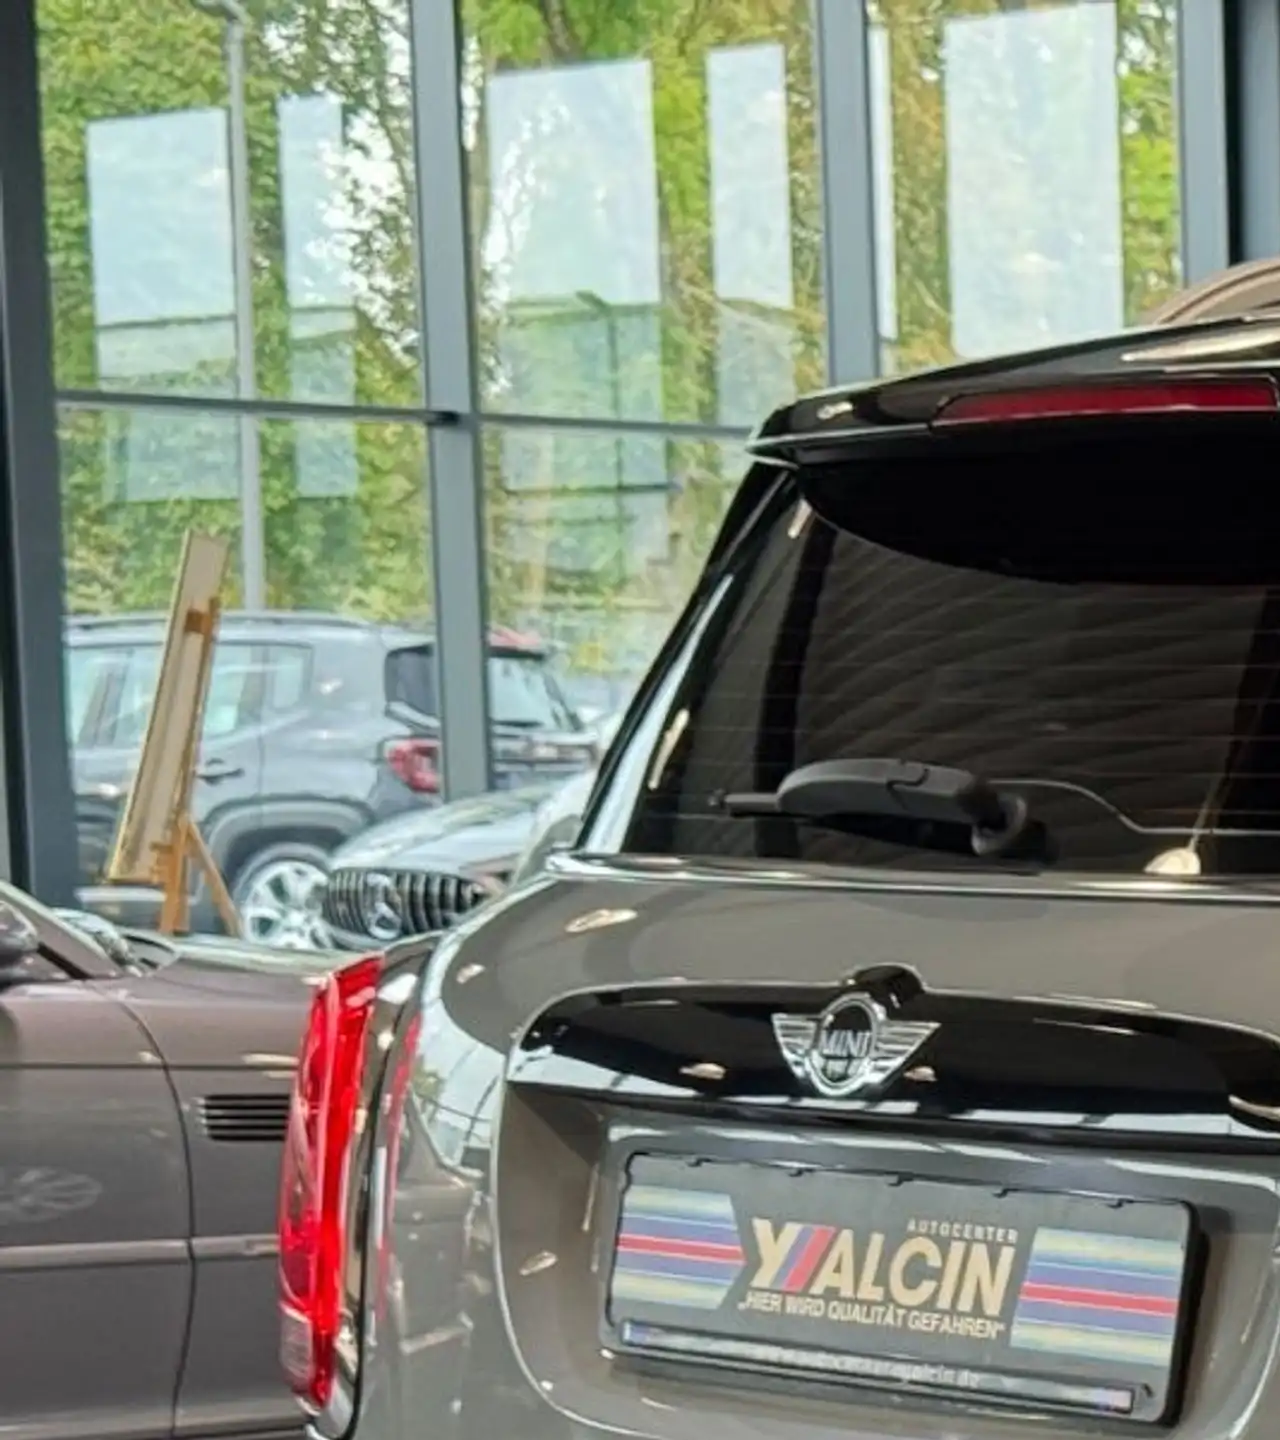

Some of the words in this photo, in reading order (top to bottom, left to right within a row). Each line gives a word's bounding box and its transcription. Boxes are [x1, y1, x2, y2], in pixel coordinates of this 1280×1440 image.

[818, 1029, 874, 1058] MINI
[906, 1218, 1018, 1245] AUTOCENTER
[784, 1294, 825, 1317] WIRD
[827, 1300, 907, 1329] QUALITÄT
